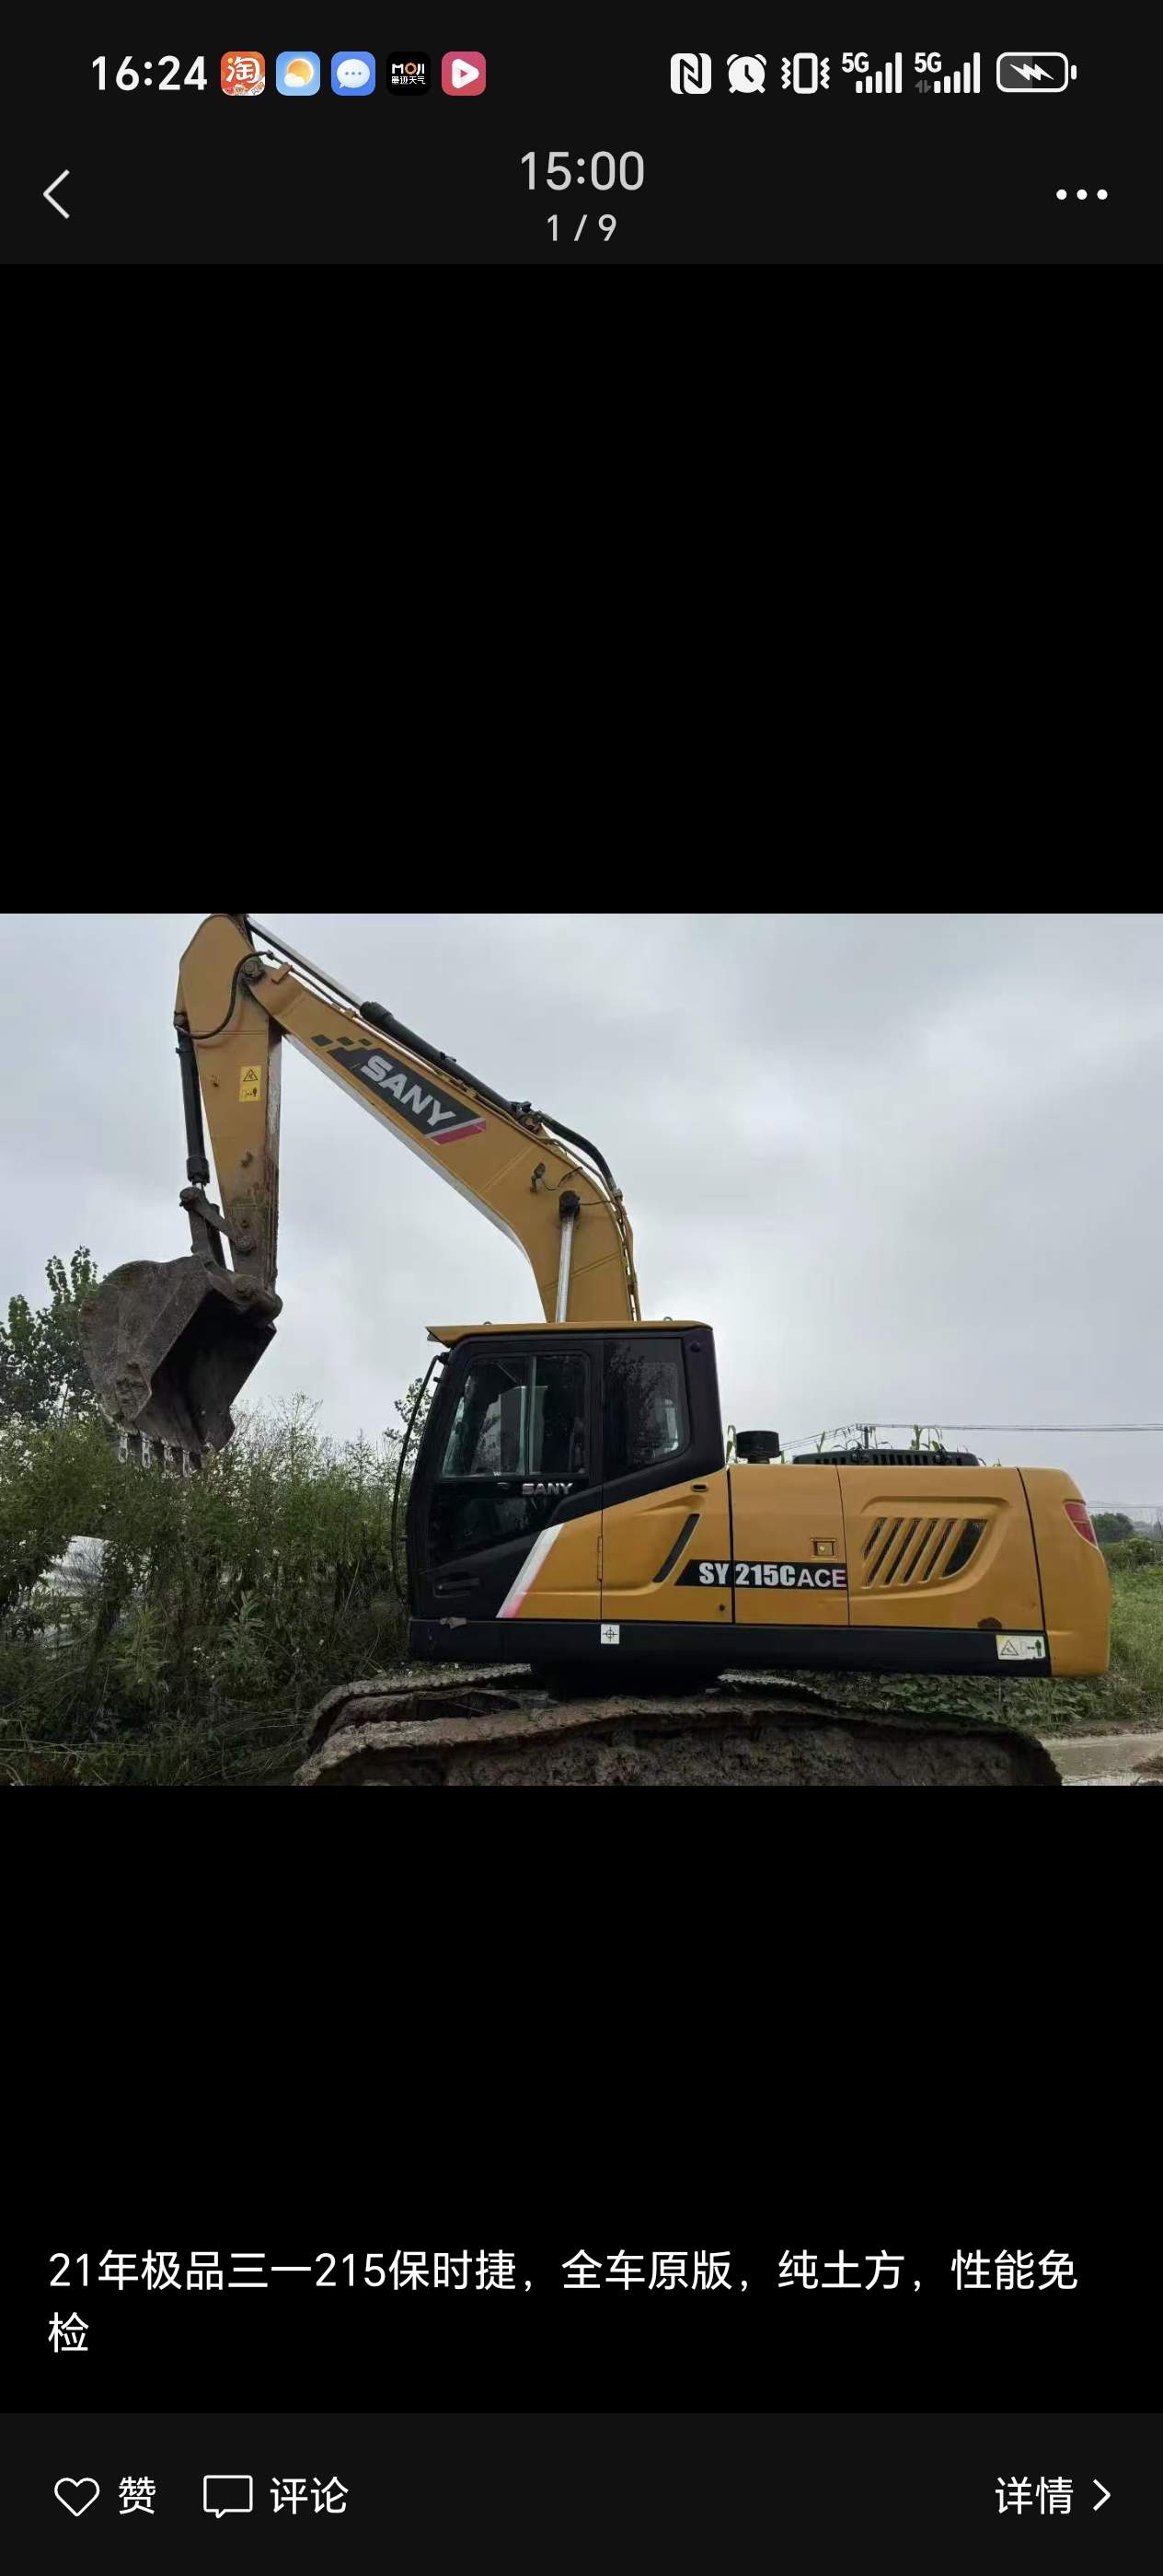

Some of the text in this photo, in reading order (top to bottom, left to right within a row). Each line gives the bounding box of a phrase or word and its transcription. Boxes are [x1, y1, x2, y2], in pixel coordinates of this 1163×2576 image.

[360, 1054, 457, 1127] SANY
[522, 1482, 573, 1495] SANY
[698, 1562, 730, 1585] SY
